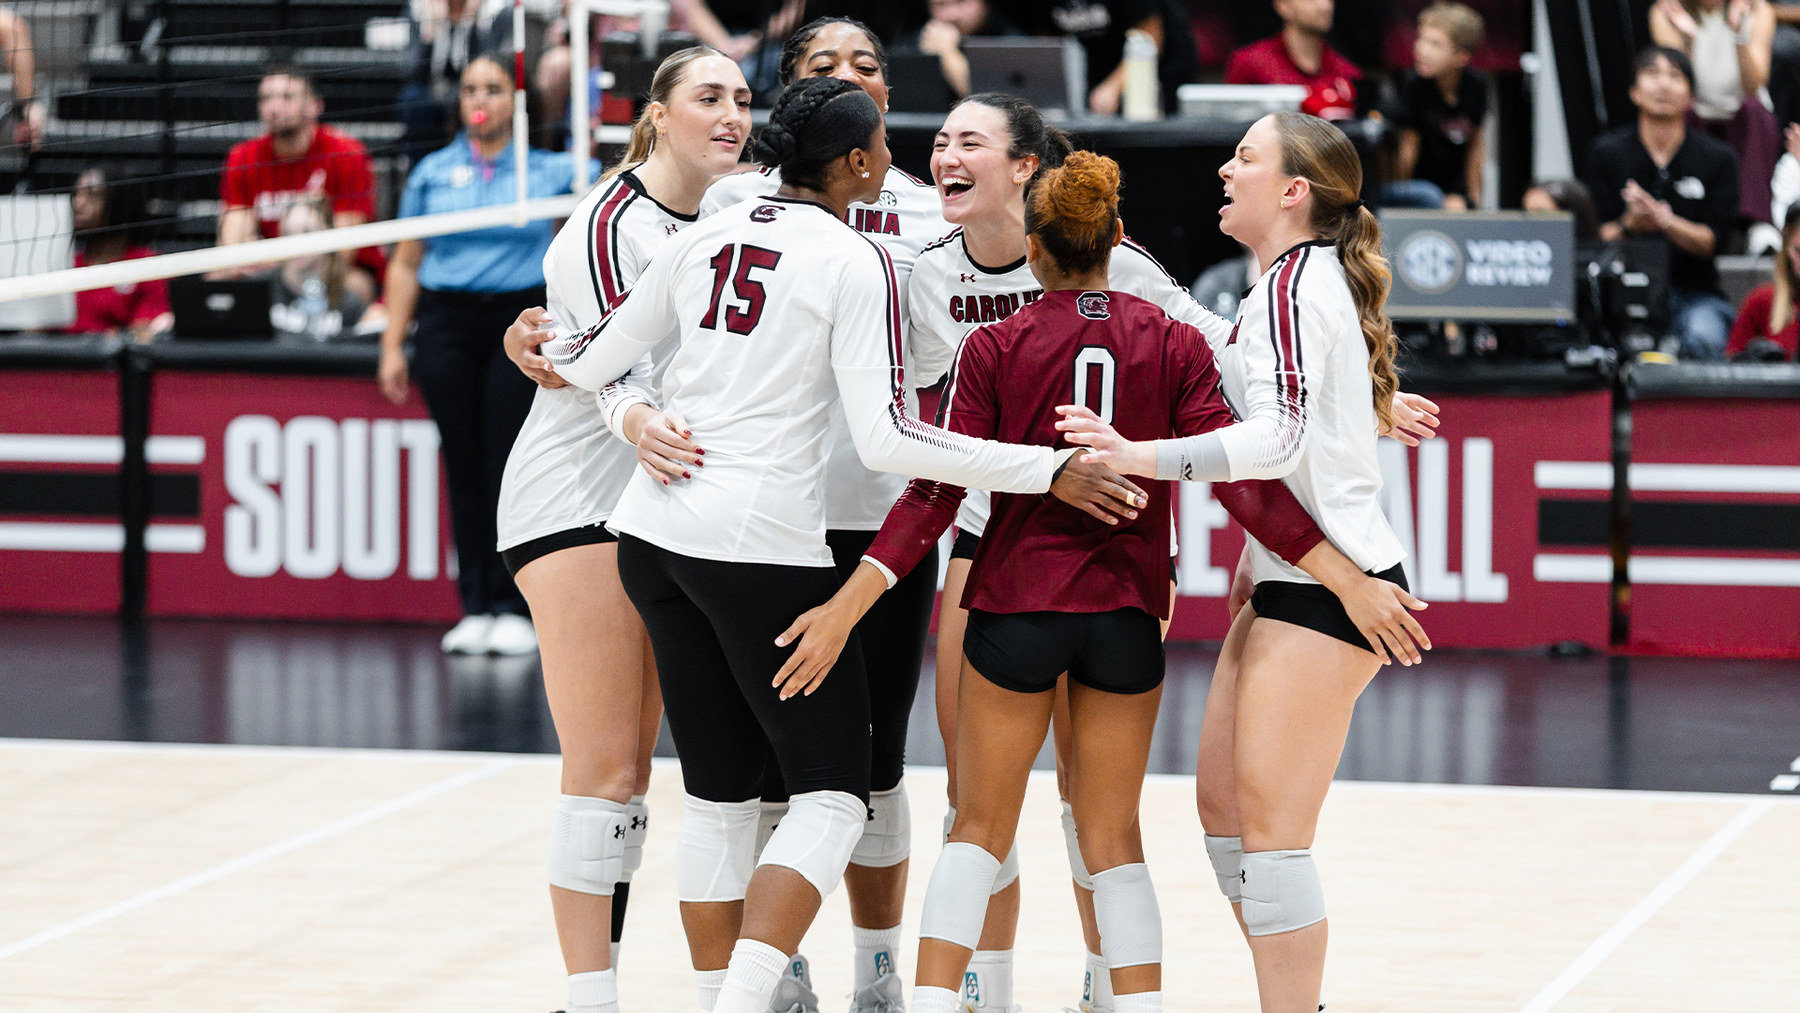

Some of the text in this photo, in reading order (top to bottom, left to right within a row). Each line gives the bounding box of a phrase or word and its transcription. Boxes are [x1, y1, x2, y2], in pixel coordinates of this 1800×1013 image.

[699, 243, 783, 336] 15
[1466, 240, 1553, 265] VIDEO
[1466, 263, 1553, 286] REVIEW
[1072, 344, 1118, 425] 0
[223, 413, 460, 581] SOUT
